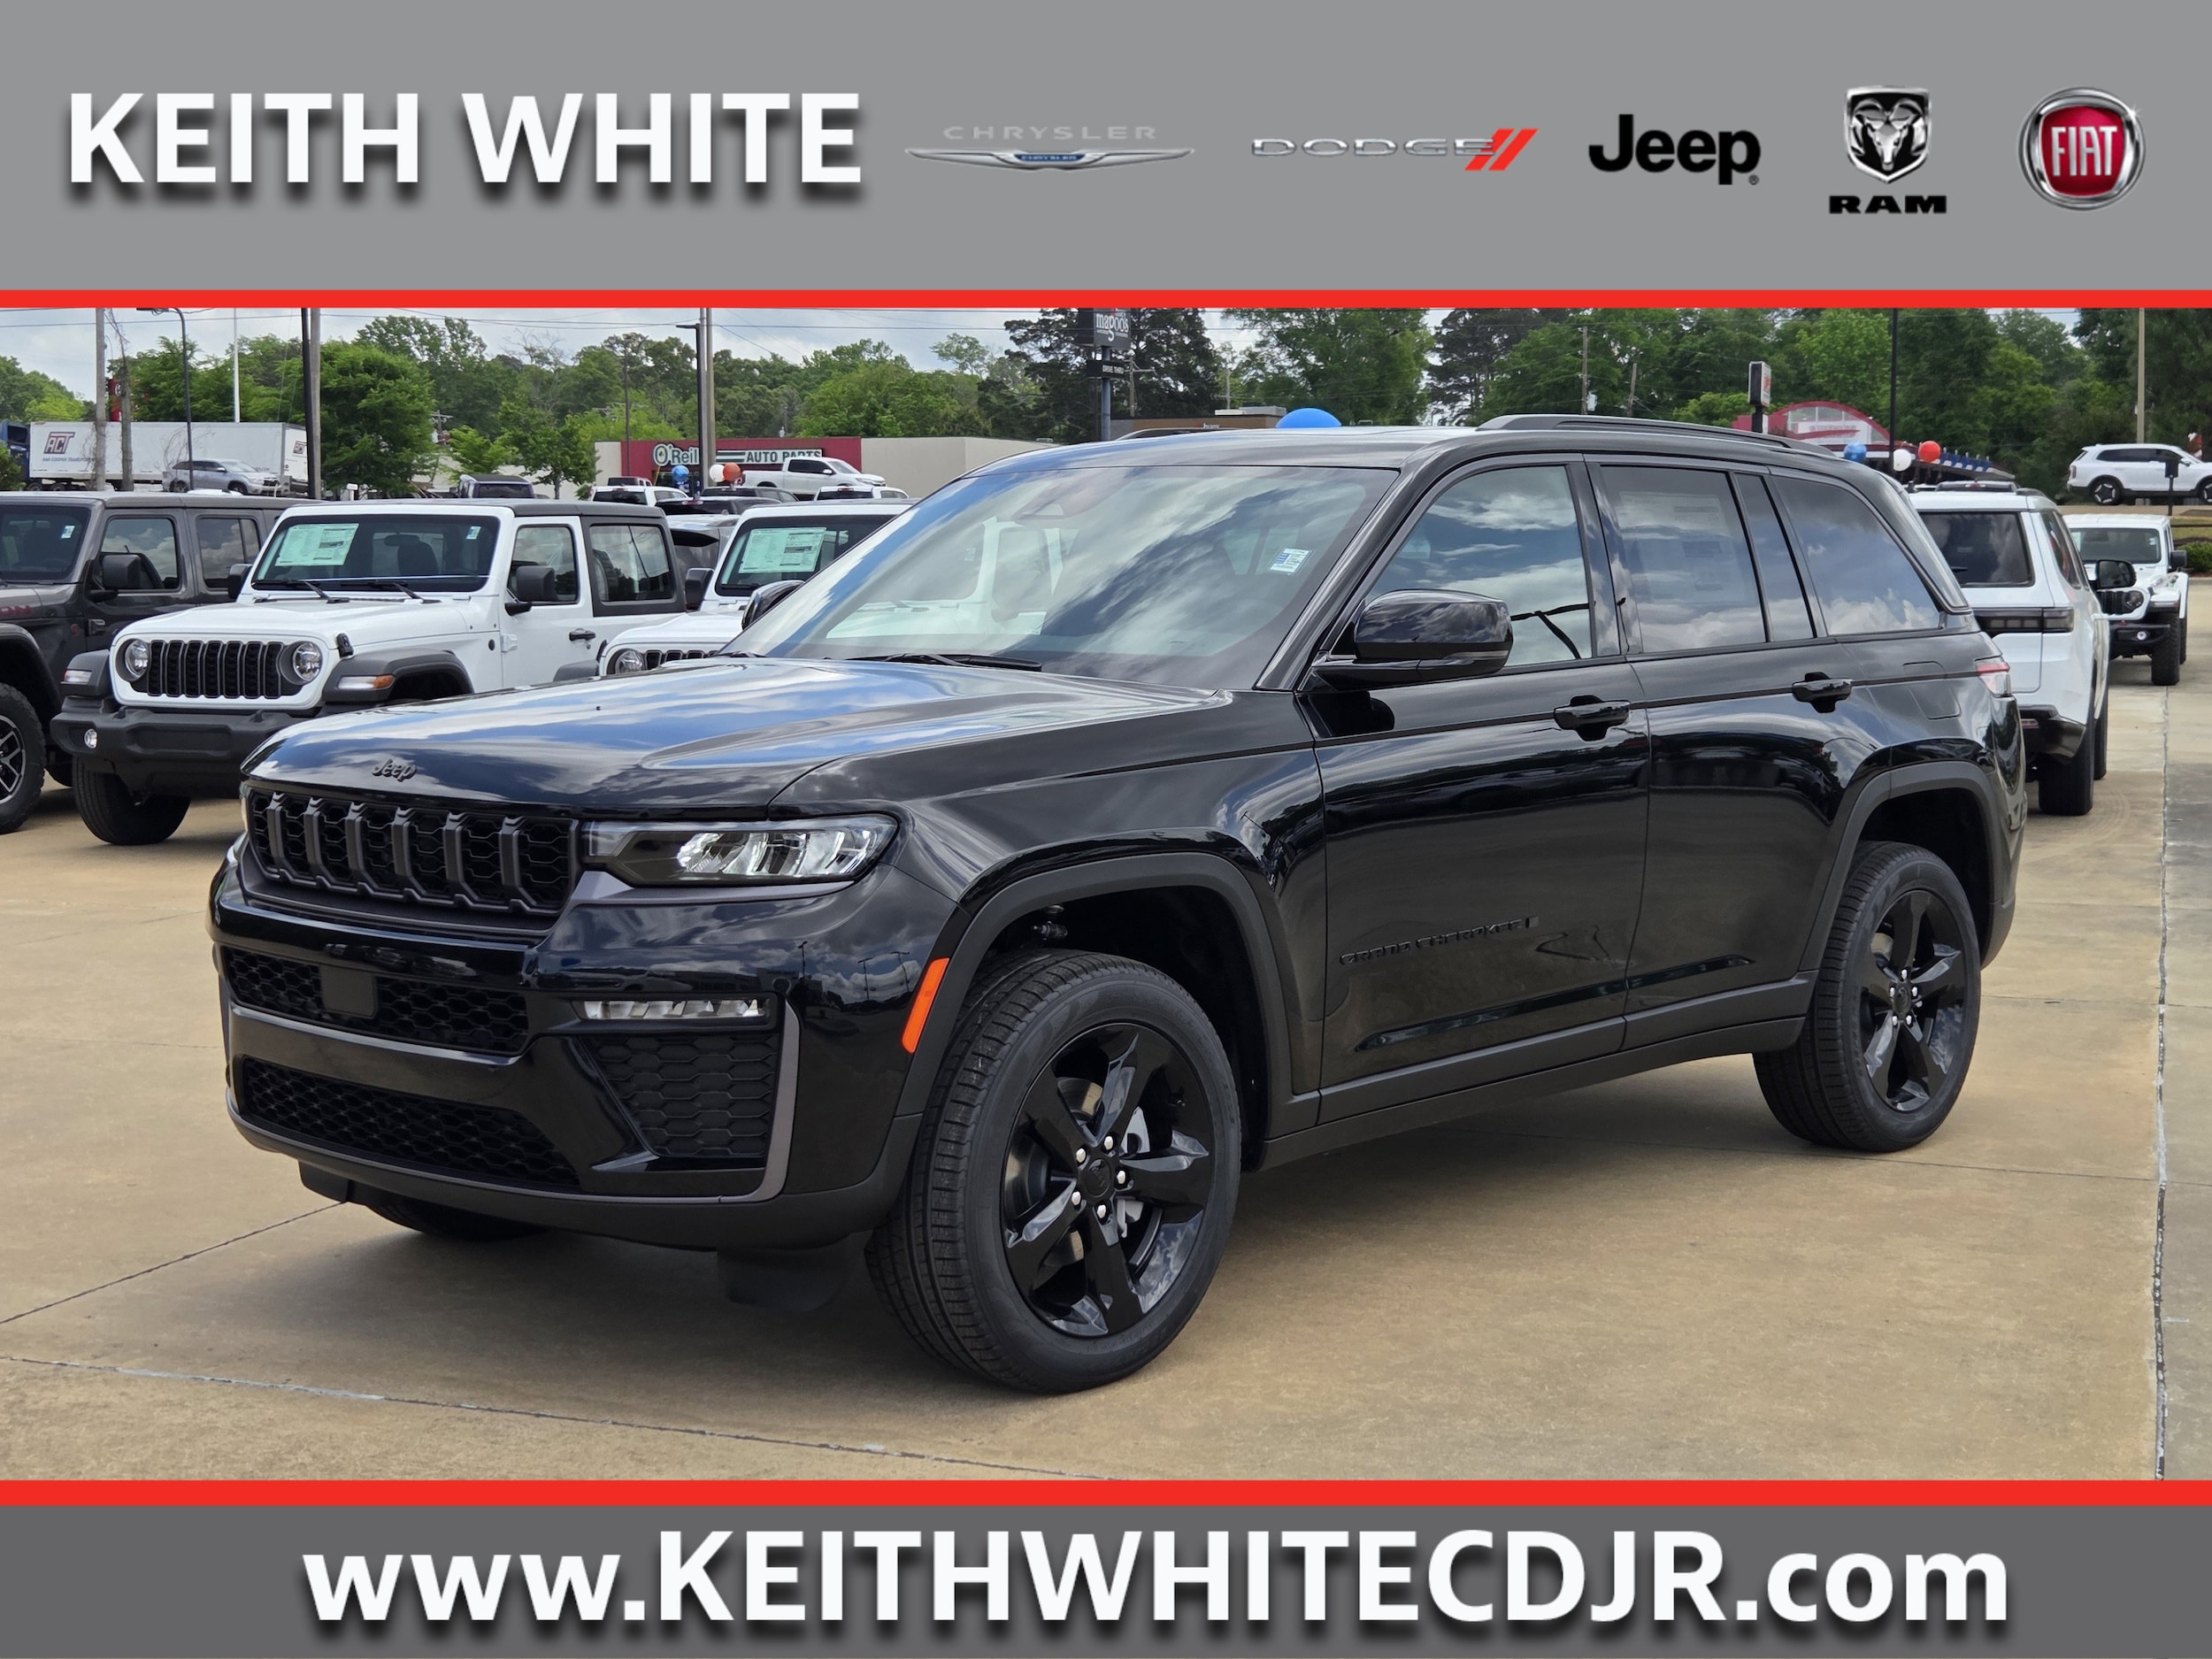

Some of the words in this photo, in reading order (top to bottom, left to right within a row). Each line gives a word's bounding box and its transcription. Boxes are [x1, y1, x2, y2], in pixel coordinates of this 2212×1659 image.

[655, 445, 699, 465] O'Reil
[746, 450, 778, 463] AUTO
[373, 758, 418, 782] Jeep
